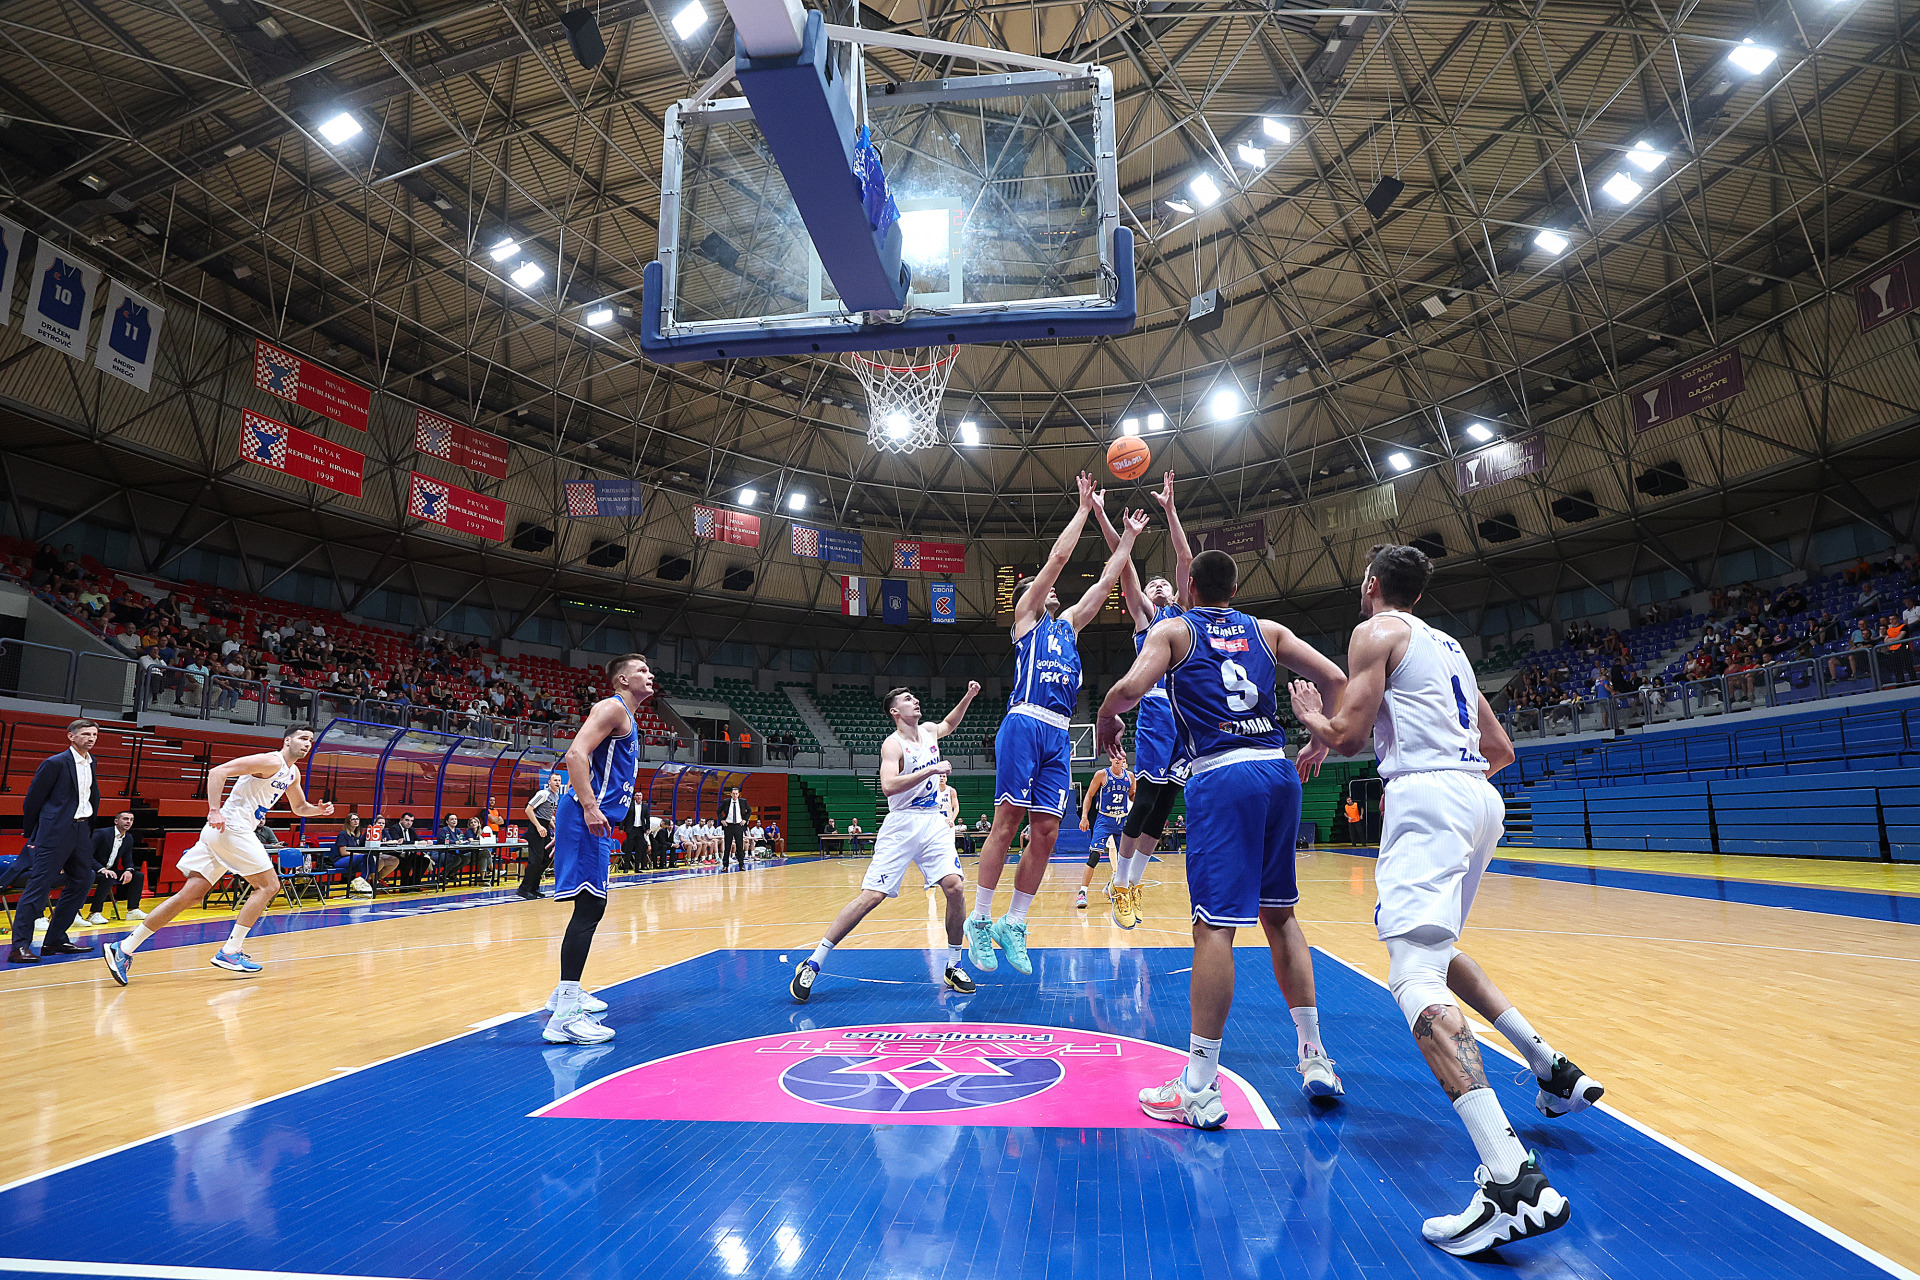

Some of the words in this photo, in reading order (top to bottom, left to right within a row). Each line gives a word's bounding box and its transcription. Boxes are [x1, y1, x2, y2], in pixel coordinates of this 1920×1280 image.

[54, 284, 72, 306] 10
[41, 321, 71, 340] DRAŽEN
[124, 322, 139, 341] 11
[38, 329, 72, 349] PETROVIĆ
[112, 364, 134, 379] KNEGO
[113, 357, 136, 372] ANDRO
[326, 380, 346, 394] PRVAK
[300, 382, 336, 402] REPUBLIKE
[337, 397, 369, 415] HRVATSKE
[326, 406, 342, 416] 1993
[472, 438, 490, 448] PRVAK
[313, 444, 341, 460] PRVAK
[288, 448, 325, 466] REPUBLIKE
[329, 463, 360, 478] HRVATSKE
[470, 458, 486, 468] 1994
[1112, 456, 1142, 470] Wilson
[316, 471, 334, 482] 1998
[467, 498, 489, 510] PRVAK
[448, 503, 478, 518] REPUBLIKE
[478, 513, 504, 526] HRVATSKE
[466, 520, 485, 531] 1997
[1206, 623, 1246, 638] ŽGANEC
[1047, 634, 1062, 656] 14
[1040, 672, 1062, 683] PSK
[1220, 659, 1258, 712] 9
[1451, 674, 1470, 729] 1
[1232, 716, 1274, 736] ZADAR
[841, 1032, 902, 1042] liga
[909, 1032, 1054, 1043] Premijer
